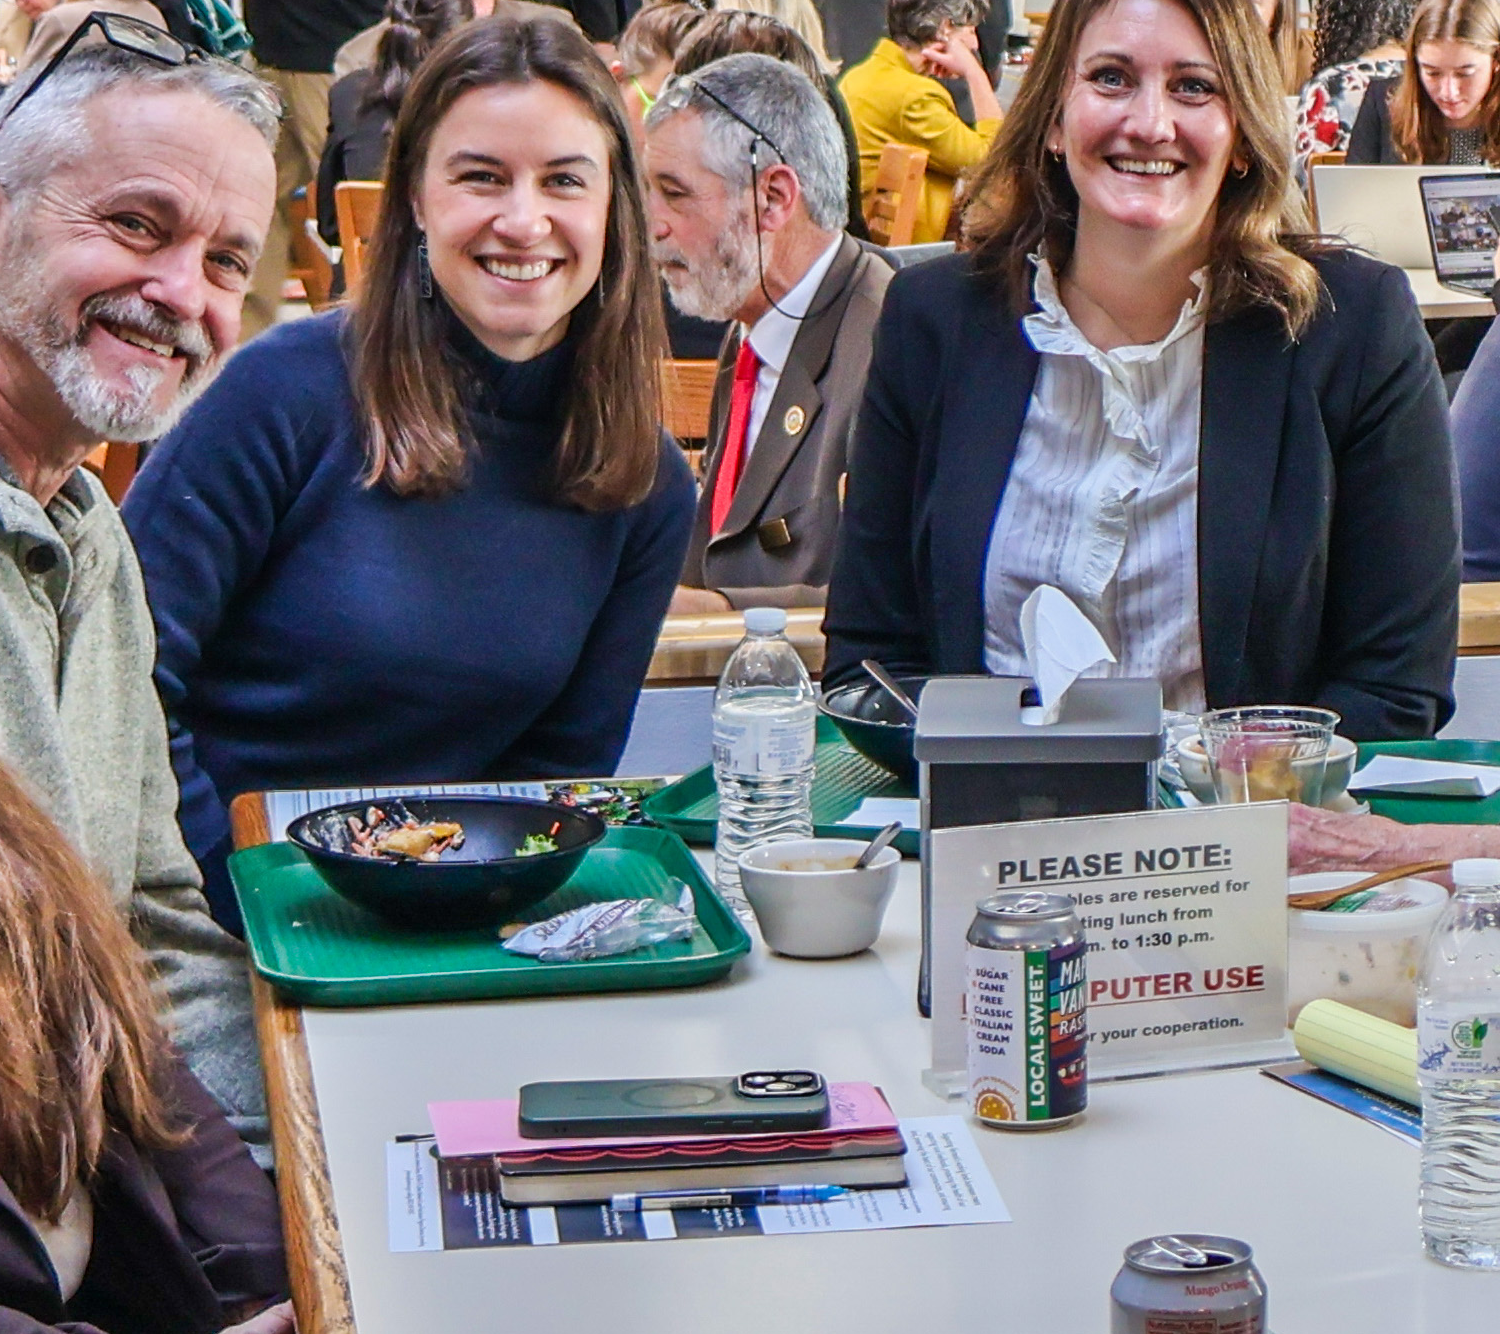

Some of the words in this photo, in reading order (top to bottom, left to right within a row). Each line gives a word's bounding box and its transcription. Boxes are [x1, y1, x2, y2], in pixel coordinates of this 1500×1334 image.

[998, 851, 1123, 885] PLEASE
[1134, 843, 1232, 873] NOTE:
[1068, 892, 1104, 907] bles
[1109, 891, 1138, 904] are
[1143, 880, 1220, 901] reserved
[1225, 878, 1251, 894] for
[1080, 916, 1114, 930] ting
[1119, 909, 1168, 927] lunch
[1173, 905, 1213, 922] from
[1085, 942, 1106, 953] m.
[1111, 936, 1129, 951] to
[1134, 932, 1172, 948] 1:30
[1178, 931, 1215, 949] p.m.
[976, 968, 1009, 980] SUGAR
[978, 981, 1005, 993] CANE
[1090, 970, 1194, 1002] PUTER
[1203, 964, 1265, 991] USE
[980, 994, 1003, 1005] FREE
[974, 1005, 1013, 1018] CLASSIC
[974, 1018, 1013, 1031] ITALIAN
[1102, 1025, 1137, 1044] your
[1142, 1017, 1244, 1040] cooperation.
[976, 1031, 1010, 1043] CREAM
[979, 1044, 1006, 1055] SODA
[1185, 1284, 1220, 1297] Mango
